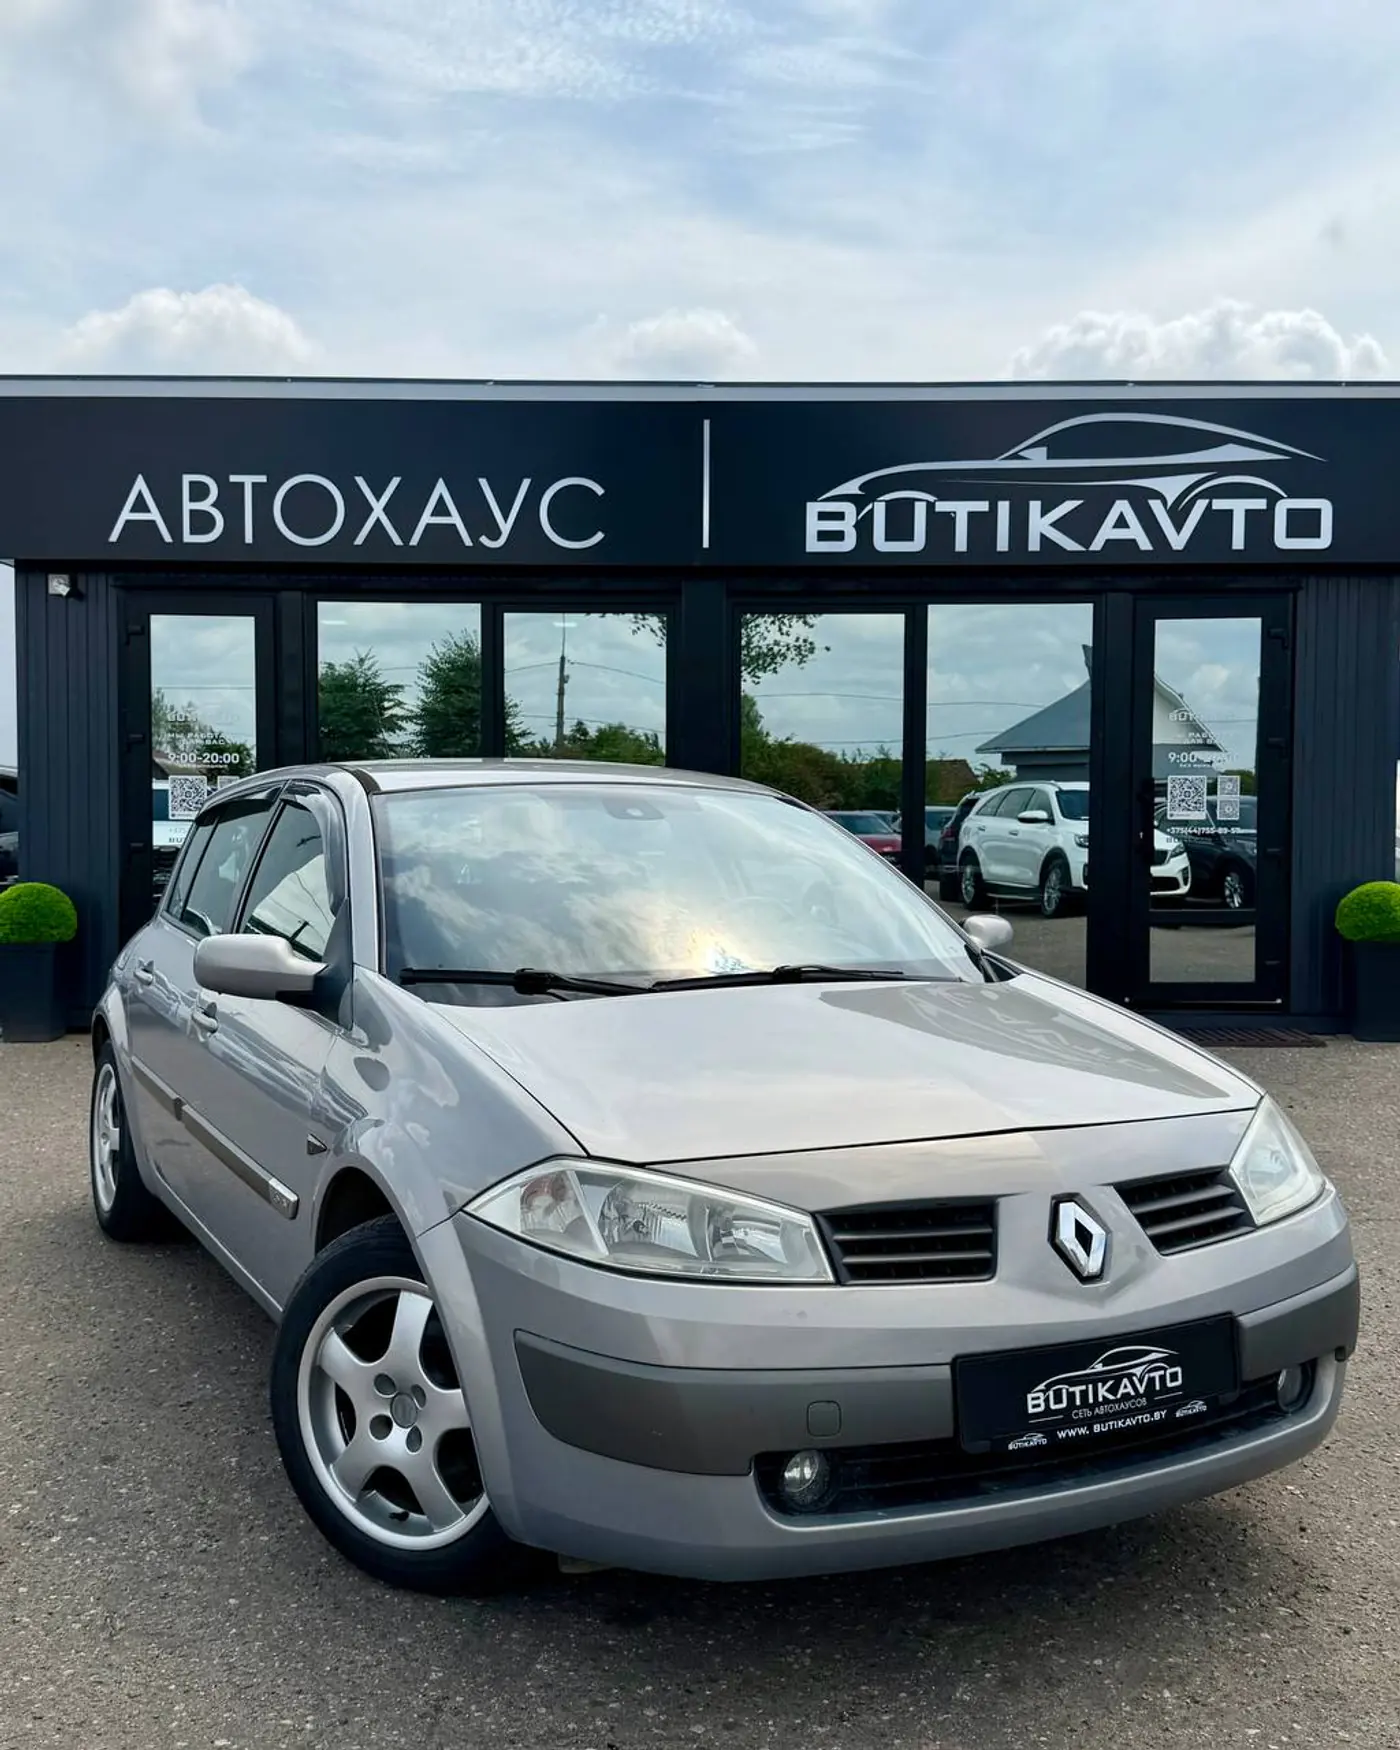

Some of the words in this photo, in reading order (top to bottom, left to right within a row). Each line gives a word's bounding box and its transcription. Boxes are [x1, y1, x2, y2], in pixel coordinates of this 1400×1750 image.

[109, 473, 605, 549] АВТОХАУС
[805, 496, 1334, 553] BUTIKAVTO
[168, 752, 240, 764] 9:00-20:00
[1027, 1366, 1183, 1414] BUTIKAVTO
[1072, 1408, 1092, 1419] СЕТЬ
[1093, 1397, 1148, 1415] АВТОХАУСОВ
[1056, 1425, 1090, 1439] WWW.
[1093, 1409, 1168, 1433] BUTIKAVTO.BY
